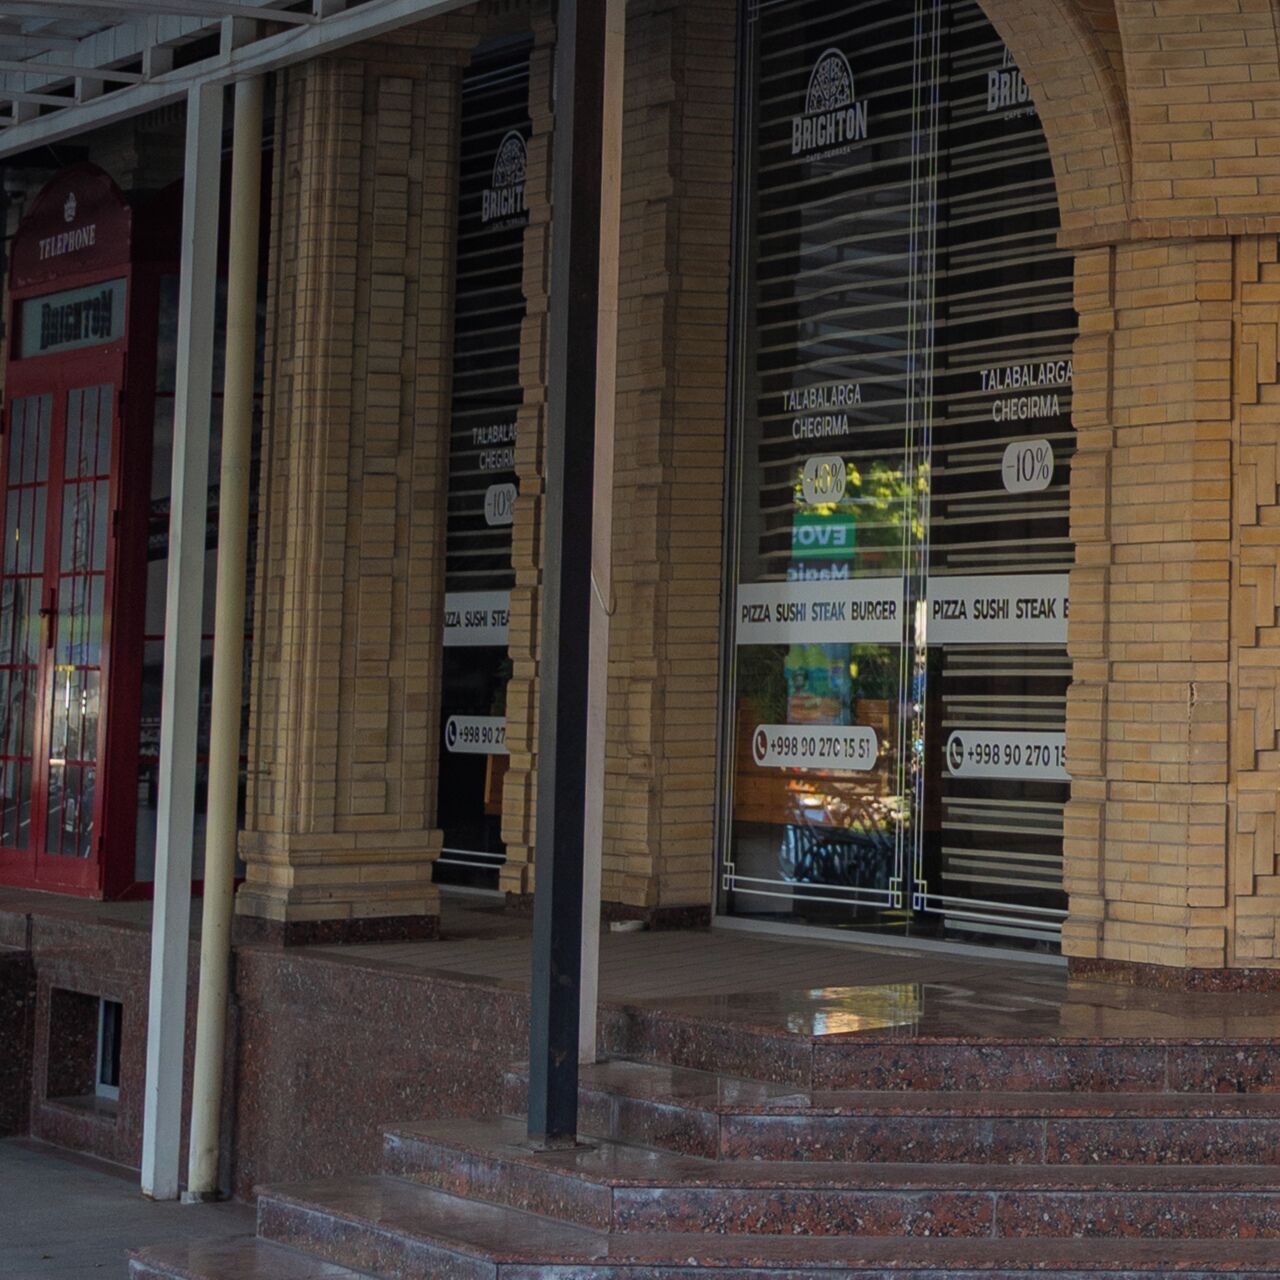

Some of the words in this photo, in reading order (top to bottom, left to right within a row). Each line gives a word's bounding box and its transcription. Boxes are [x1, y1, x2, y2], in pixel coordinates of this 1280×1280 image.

[987, 70, 1032, 111] BRIG
[792, 100, 868, 155] BRIGHTON
[39, 224, 96, 260] TELEPHONE
[40, 288, 113, 351] BRIGHTON
[980, 360, 1073, 391] TALABALARGA
[782, 384, 861, 411] TALABALARGA
[992, 394, 1060, 422] CHEGIRMA
[792, 415, 849, 440] CHEGIRMA
[806, 463, 843, 495] -10%
[1006, 448, 1049, 483] -10%
[465, 610, 488, 627] SUSHI
[742, 600, 771, 623] PIZZA
[776, 601, 806, 622] SUSHI
[812, 601, 846, 621] STEAK
[851, 599, 897, 621] BURGER
[933, 599, 967, 620] PIZZA
[973, 598, 1009, 619] SUSHI
[1016, 598, 1057, 619] STEAK
[459, 726, 480, 743] +998
[482, 726, 493, 743] 90
[495, 726, 506, 744] 27
[770, 736, 798, 757] +998
[801, 736, 816, 757] 90
[819, 737, 841, 757] 270
[843, 738, 856, 759] 15
[859, 738, 870, 759] 51
[967, 744, 1000, 765] +998
[1003, 744, 1021, 766] 90
[1025, 745, 1050, 766] 270
